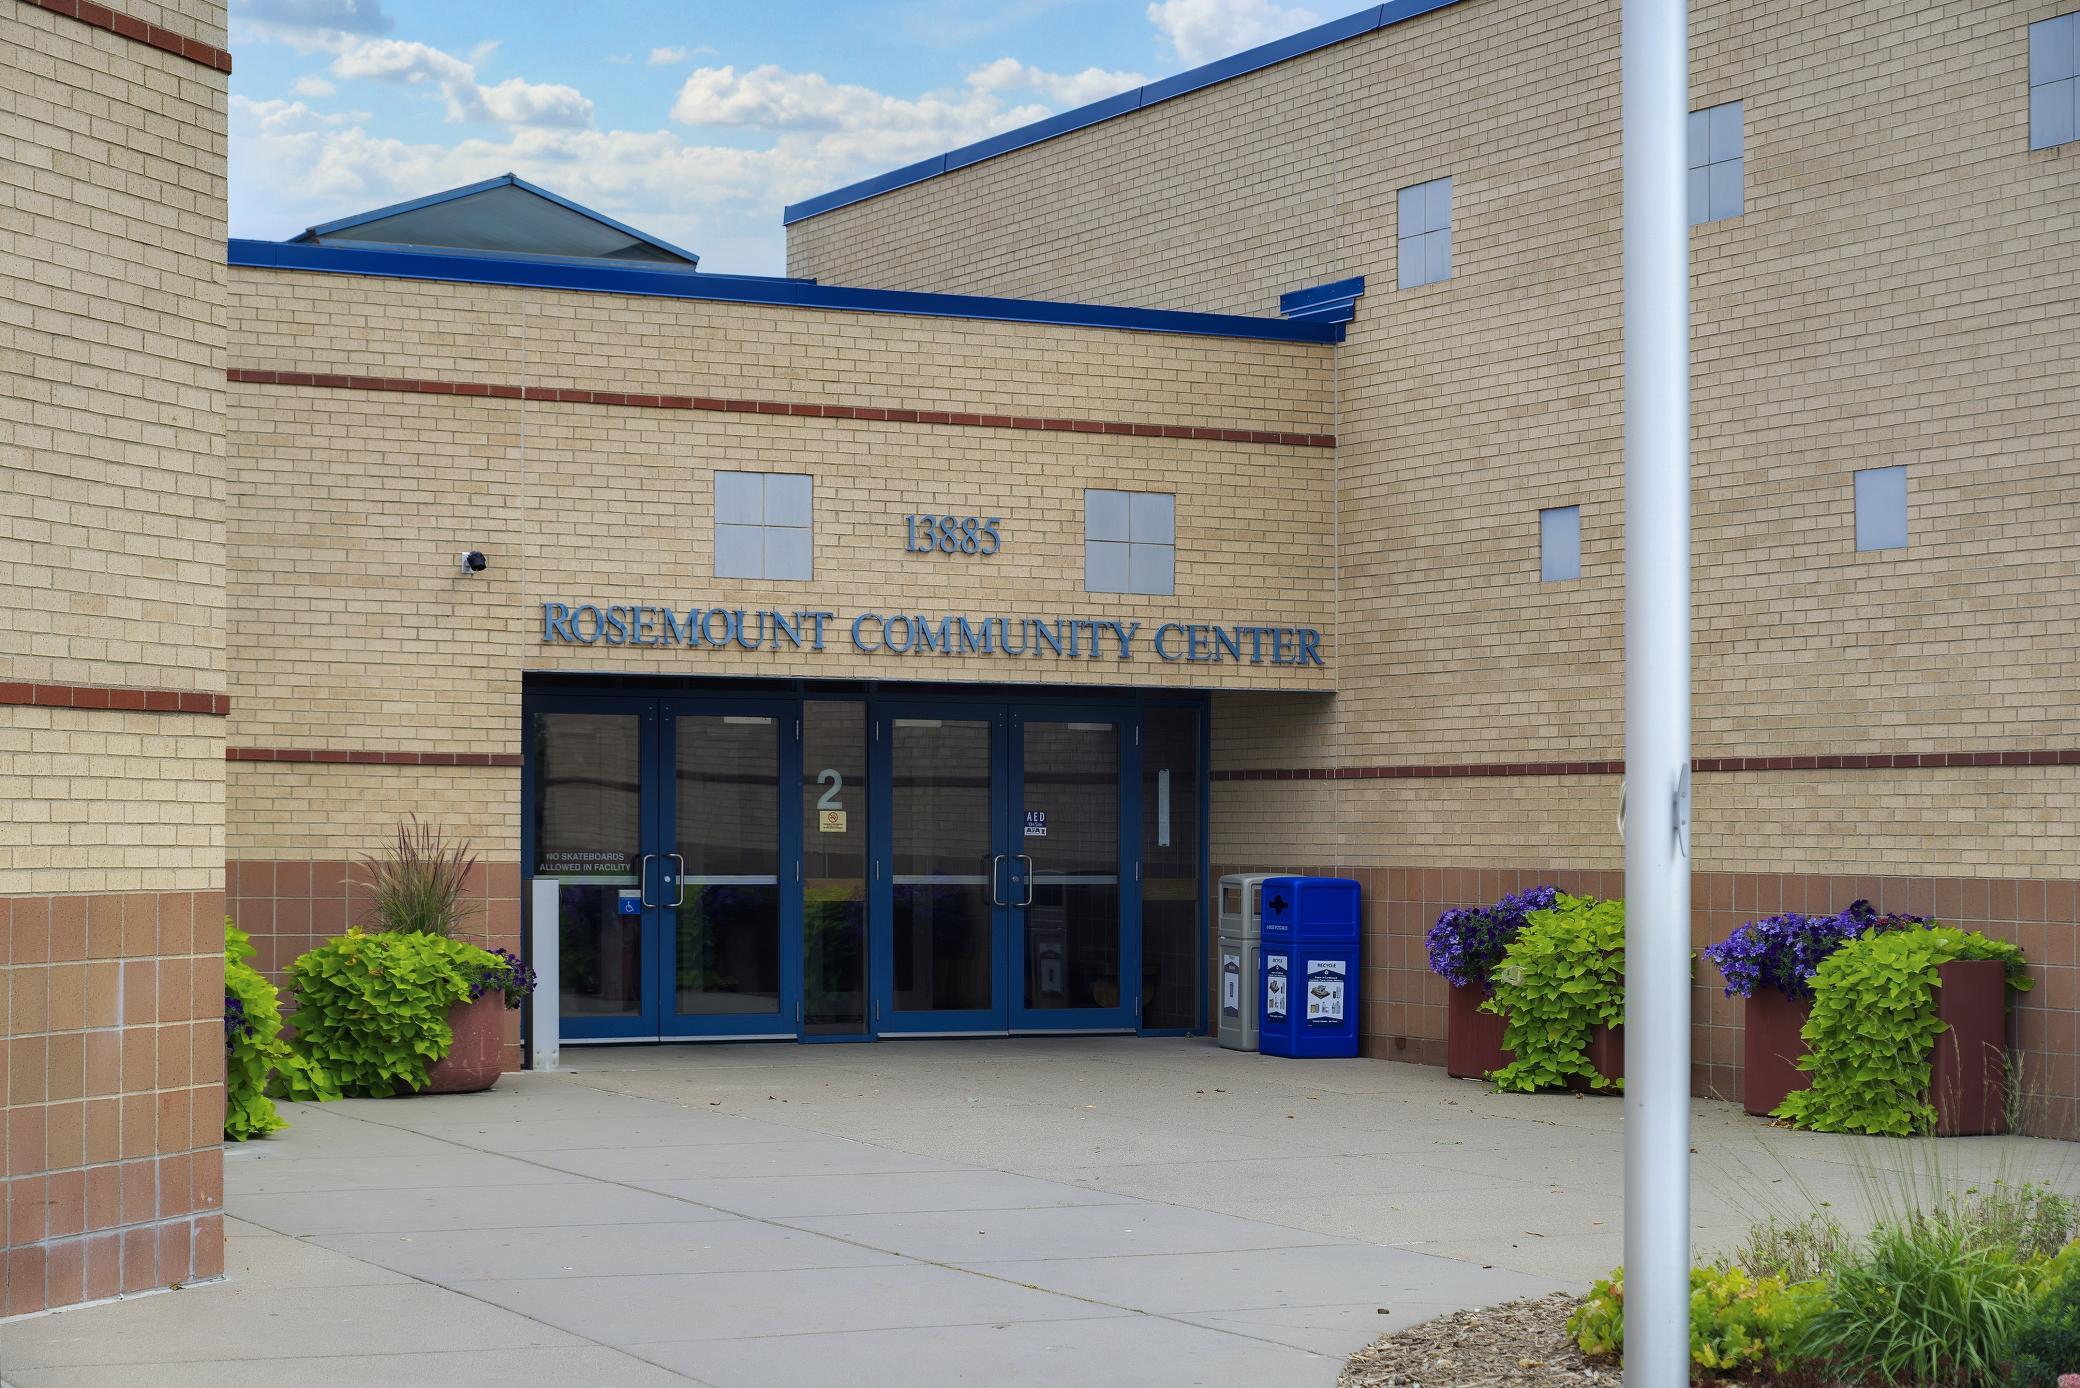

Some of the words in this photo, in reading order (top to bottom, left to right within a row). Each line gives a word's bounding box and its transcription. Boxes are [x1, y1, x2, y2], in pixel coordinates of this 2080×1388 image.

[905, 513, 1001, 555] 13885
[541, 601, 834, 650] ROSEMOUNT
[851, 612, 1142, 659] COMMUNITY
[1154, 623, 1326, 665] CENTER
[816, 768, 843, 810] 2
[1026, 811, 1045, 822] AED
[540, 863, 581, 871] ALLOWED
[583, 863, 592, 871] IN
[594, 863, 631, 871] FACILITY
[546, 852, 560, 861] NO
[561, 852, 625, 861] SKATEBOARDS
